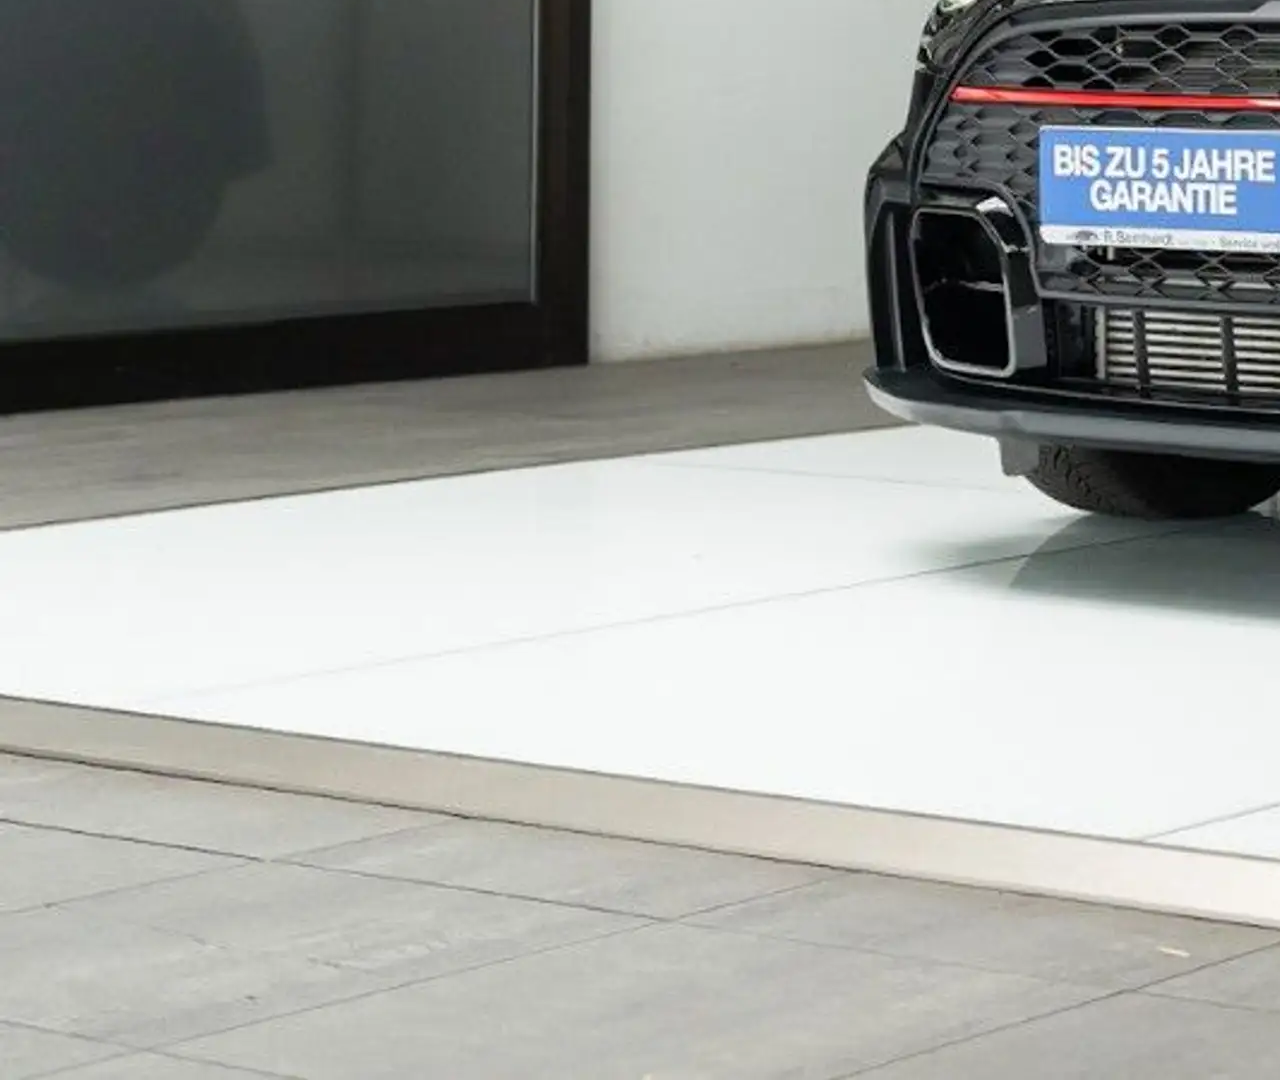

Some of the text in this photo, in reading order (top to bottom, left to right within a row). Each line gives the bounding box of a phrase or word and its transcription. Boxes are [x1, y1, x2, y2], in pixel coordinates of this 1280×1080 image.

[1053, 144, 1276, 183] BIS ZU 5 JAHRE
[1090, 179, 1238, 215] GARANTIE
